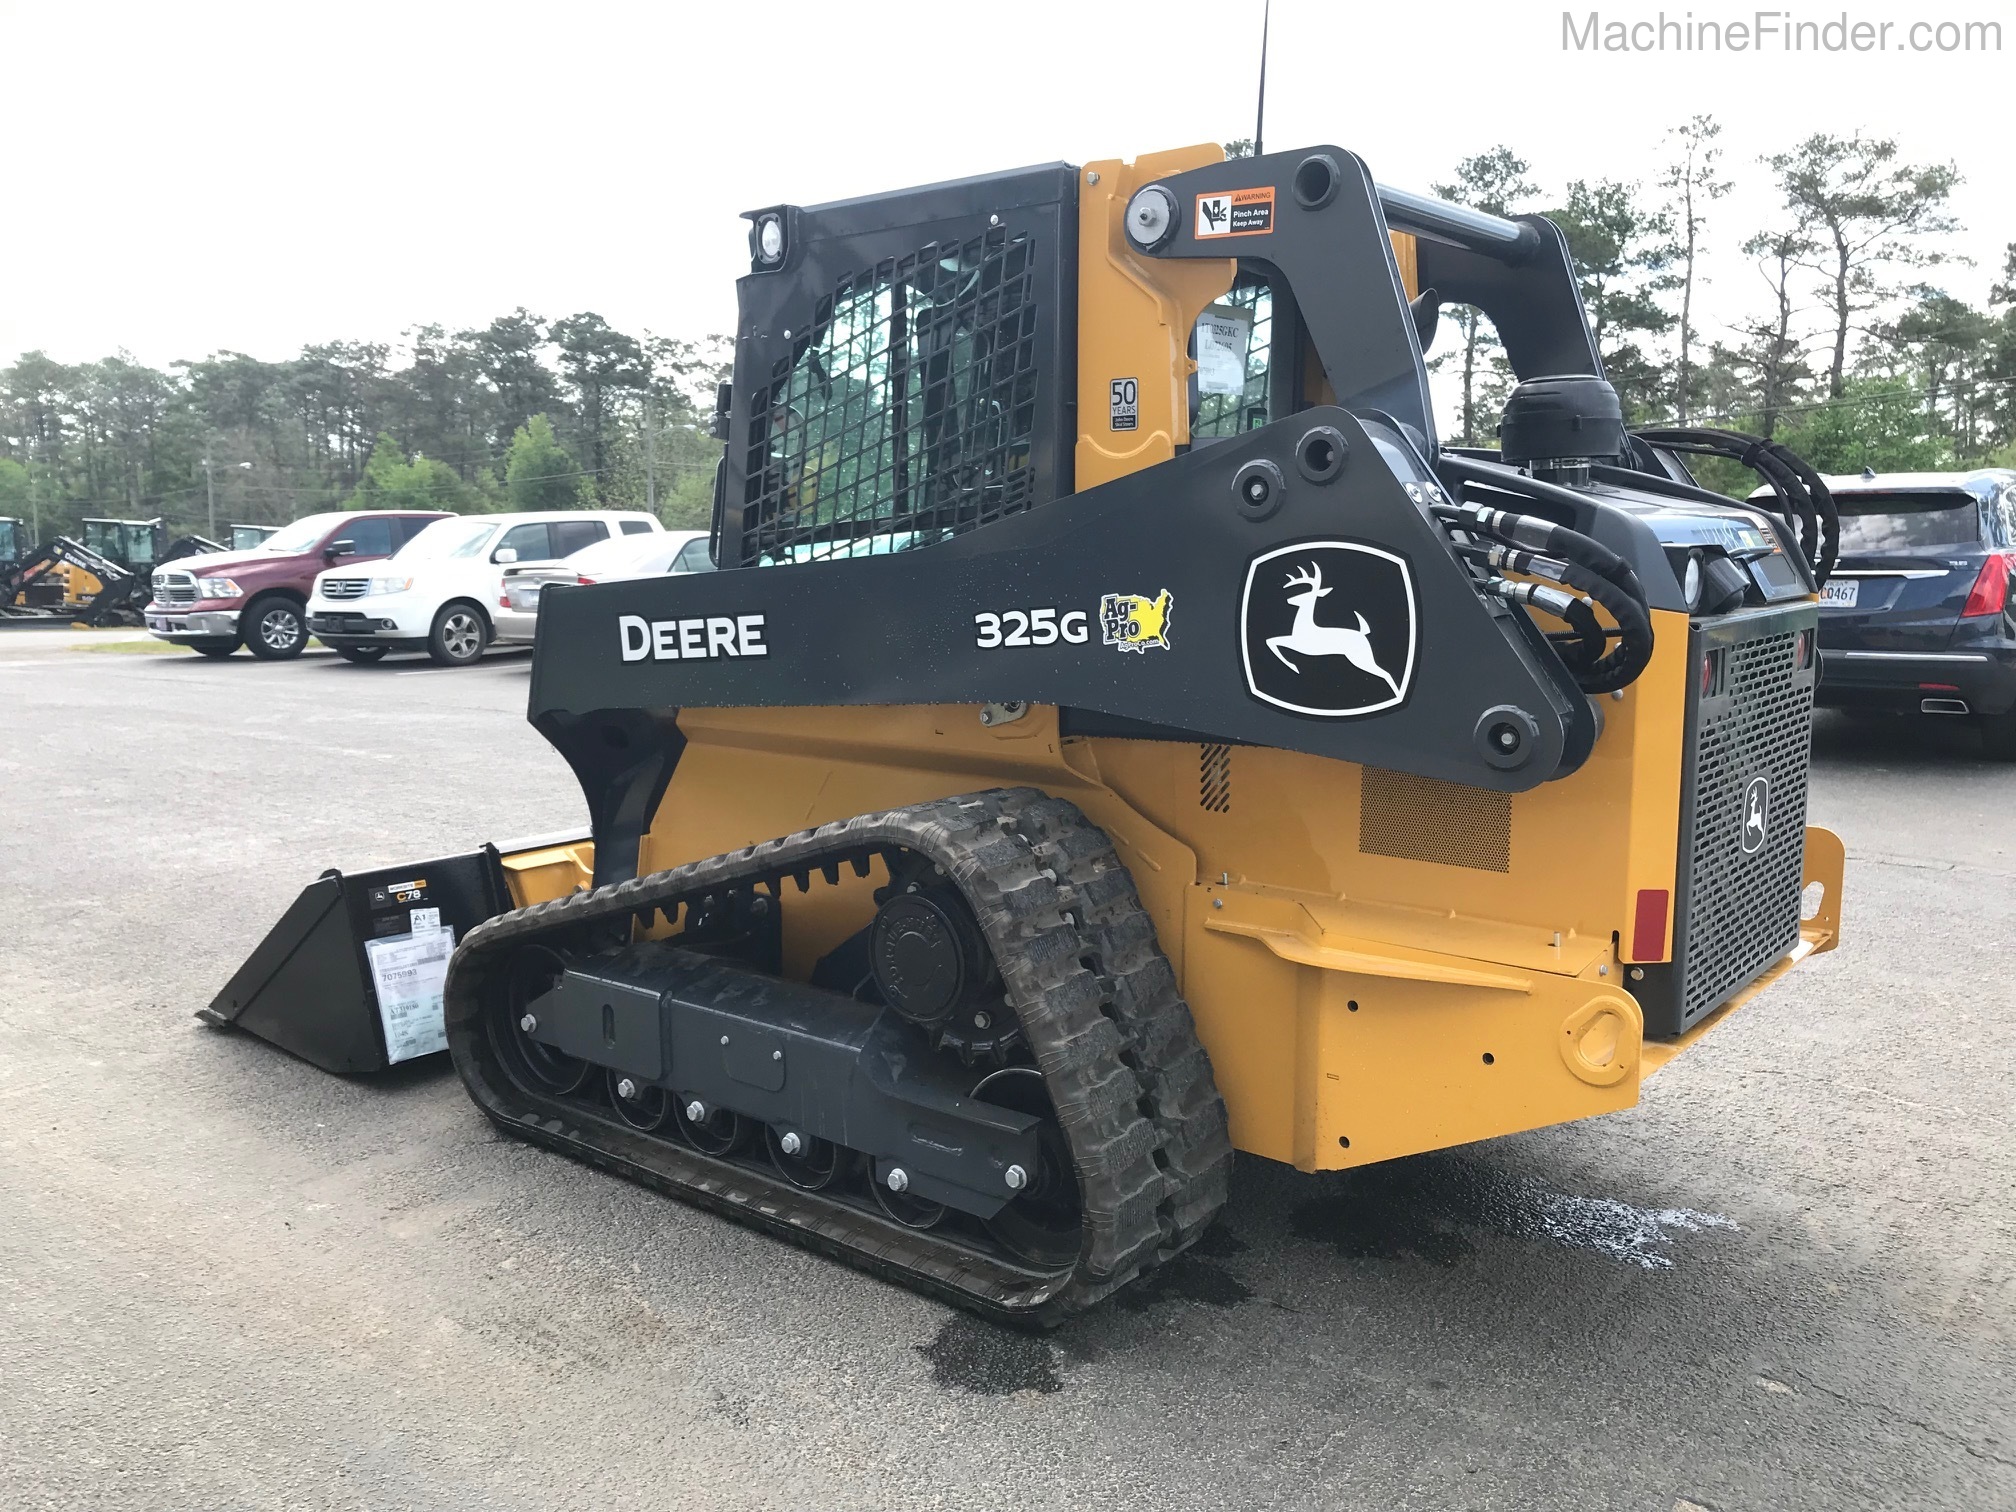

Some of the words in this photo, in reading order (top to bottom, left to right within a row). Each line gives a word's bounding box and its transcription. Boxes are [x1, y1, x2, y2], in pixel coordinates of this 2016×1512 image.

[1241, 192, 1270, 201] WARNING
[1233, 210, 1251, 218] Pinch
[1112, 380, 1136, 406] 50
[1112, 405, 1136, 415] YEARS
[1104, 597, 1137, 621] Ag-
[974, 608, 1089, 648] 325G
[1106, 620, 1140, 640] Pro
[618, 614, 767, 662] DEERE
[396, 889, 421, 901] C78
[382, 969, 417, 982] 7075993
